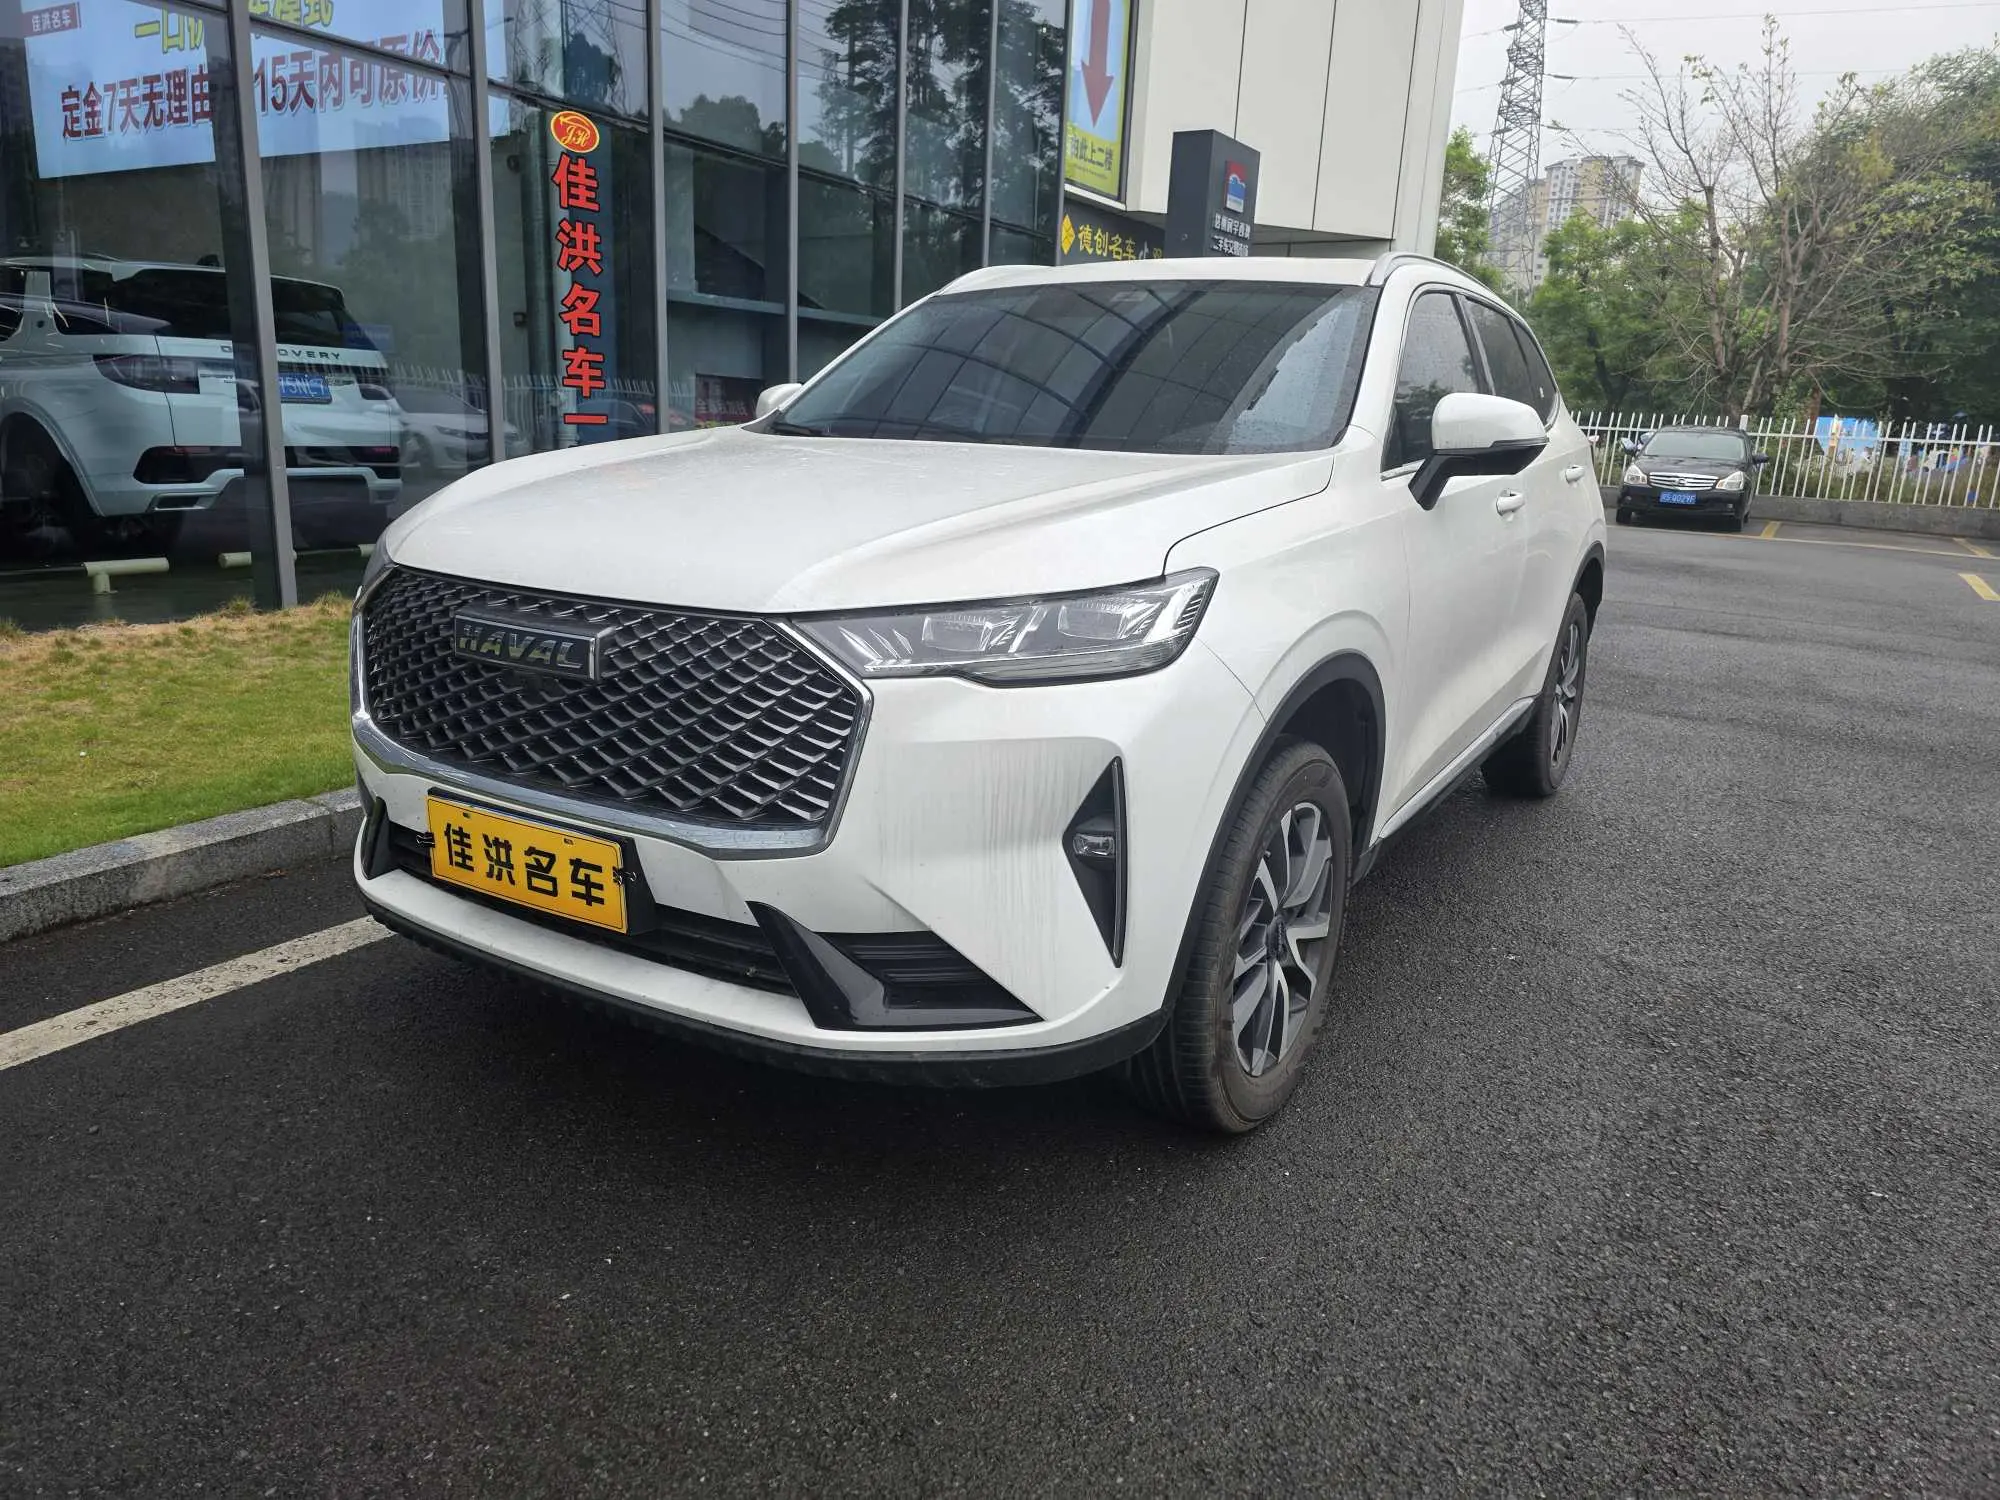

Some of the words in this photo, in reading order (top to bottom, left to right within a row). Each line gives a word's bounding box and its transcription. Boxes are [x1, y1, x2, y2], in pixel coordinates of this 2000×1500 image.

[31, 9, 73, 32] 佳洪名车
[458, 624, 583, 669] HAVAL
[444, 822, 606, 907] 佳洪名车
